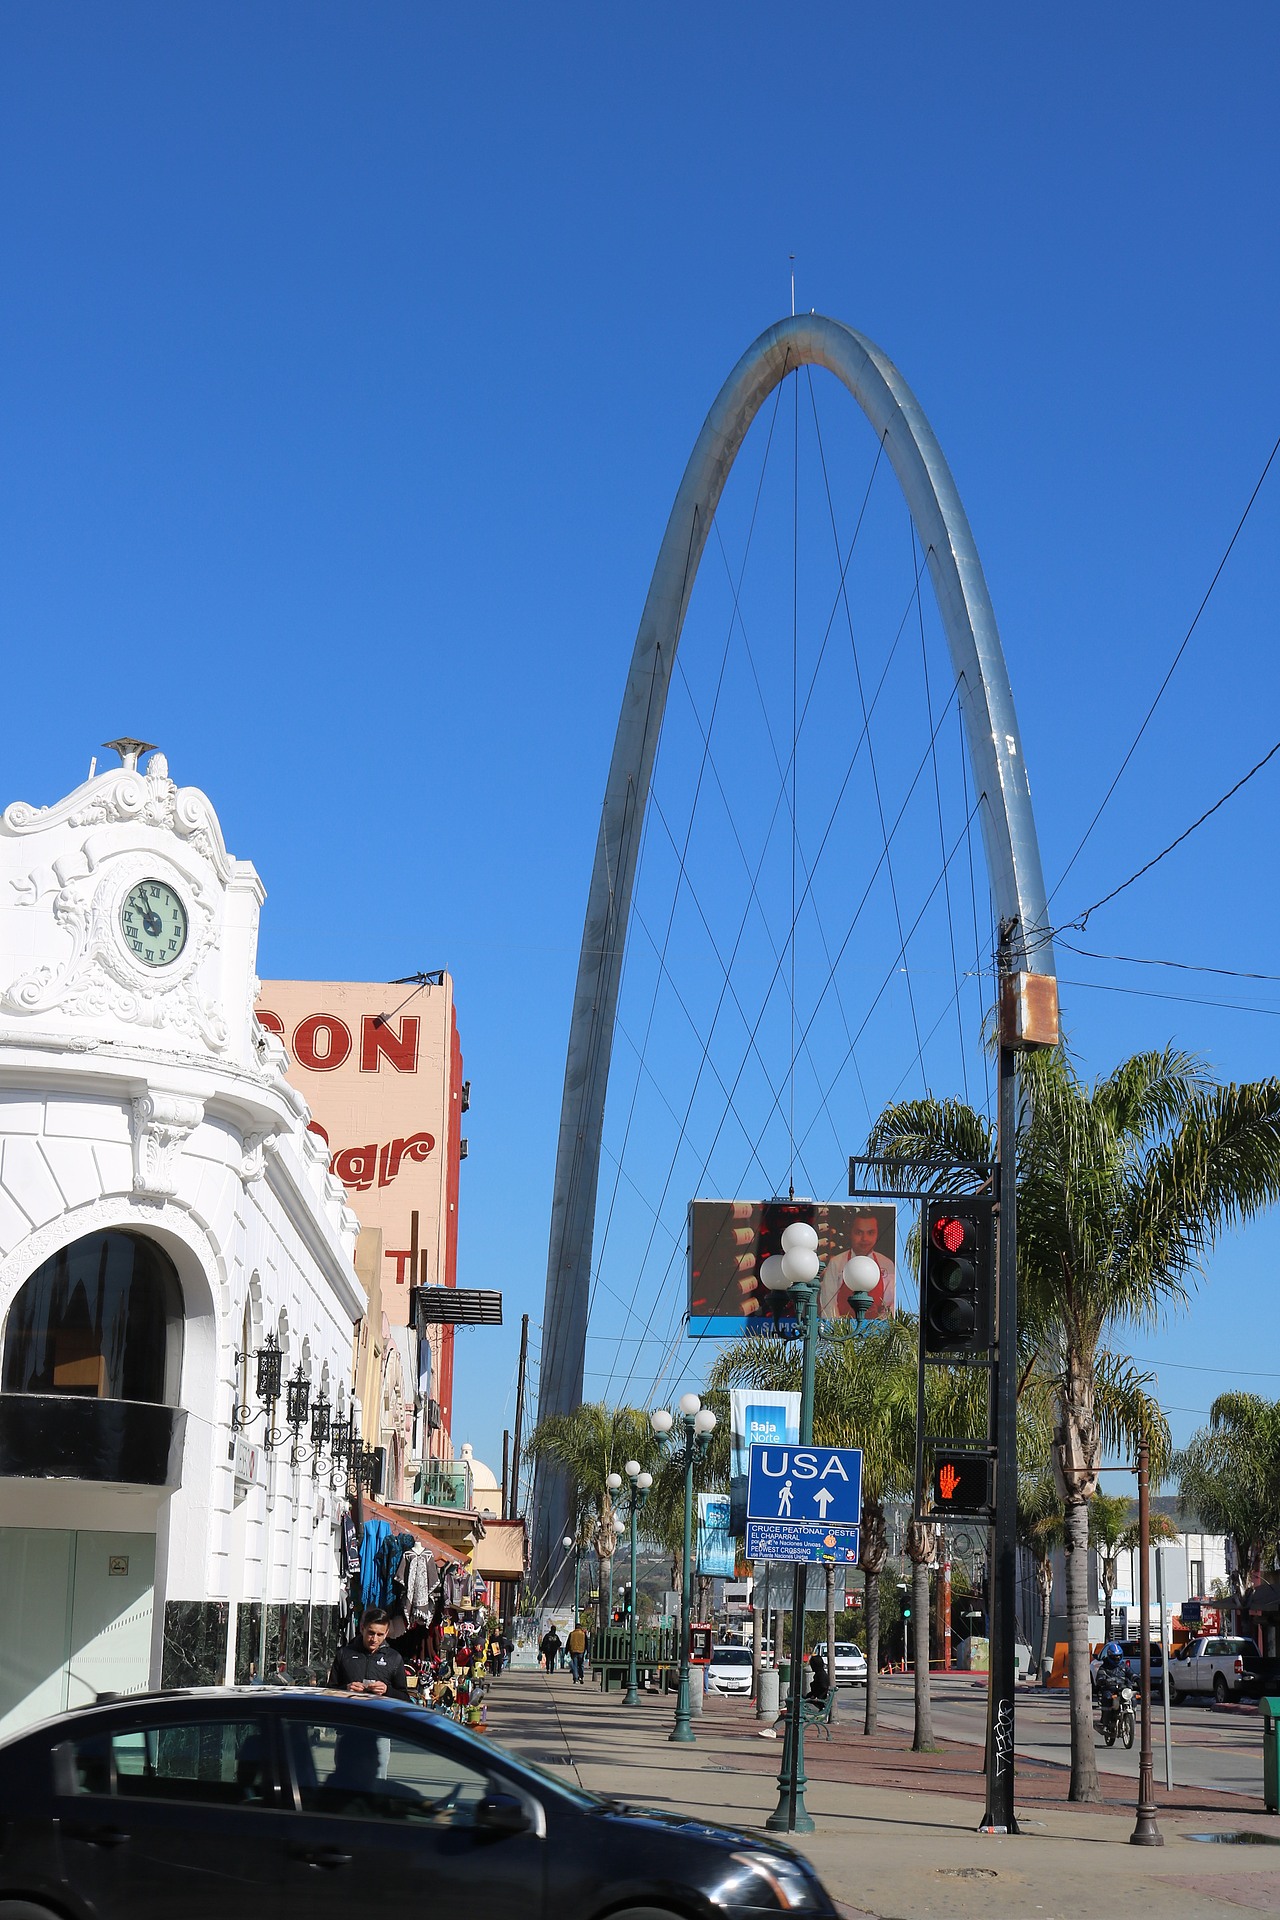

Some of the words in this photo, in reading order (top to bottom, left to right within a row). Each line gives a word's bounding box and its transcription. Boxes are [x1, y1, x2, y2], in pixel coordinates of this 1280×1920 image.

[150, 886, 161, 898] XII
[128, 896, 136, 907] X
[124, 910, 134, 923] IX
[124, 925, 139, 939] VIII
[168, 939, 177, 951] IV
[144, 949, 155, 961] VI
[750, 1421, 777, 1434] Baja
[750, 1432, 780, 1442] Norte
[762, 1451, 849, 1481] USA
[751, 1525, 781, 1533] CRUCE
[782, 1526, 825, 1536] PEATONAL
[828, 1529, 856, 1537] OESTE
[780, 1547, 811, 1555] CROSSING
